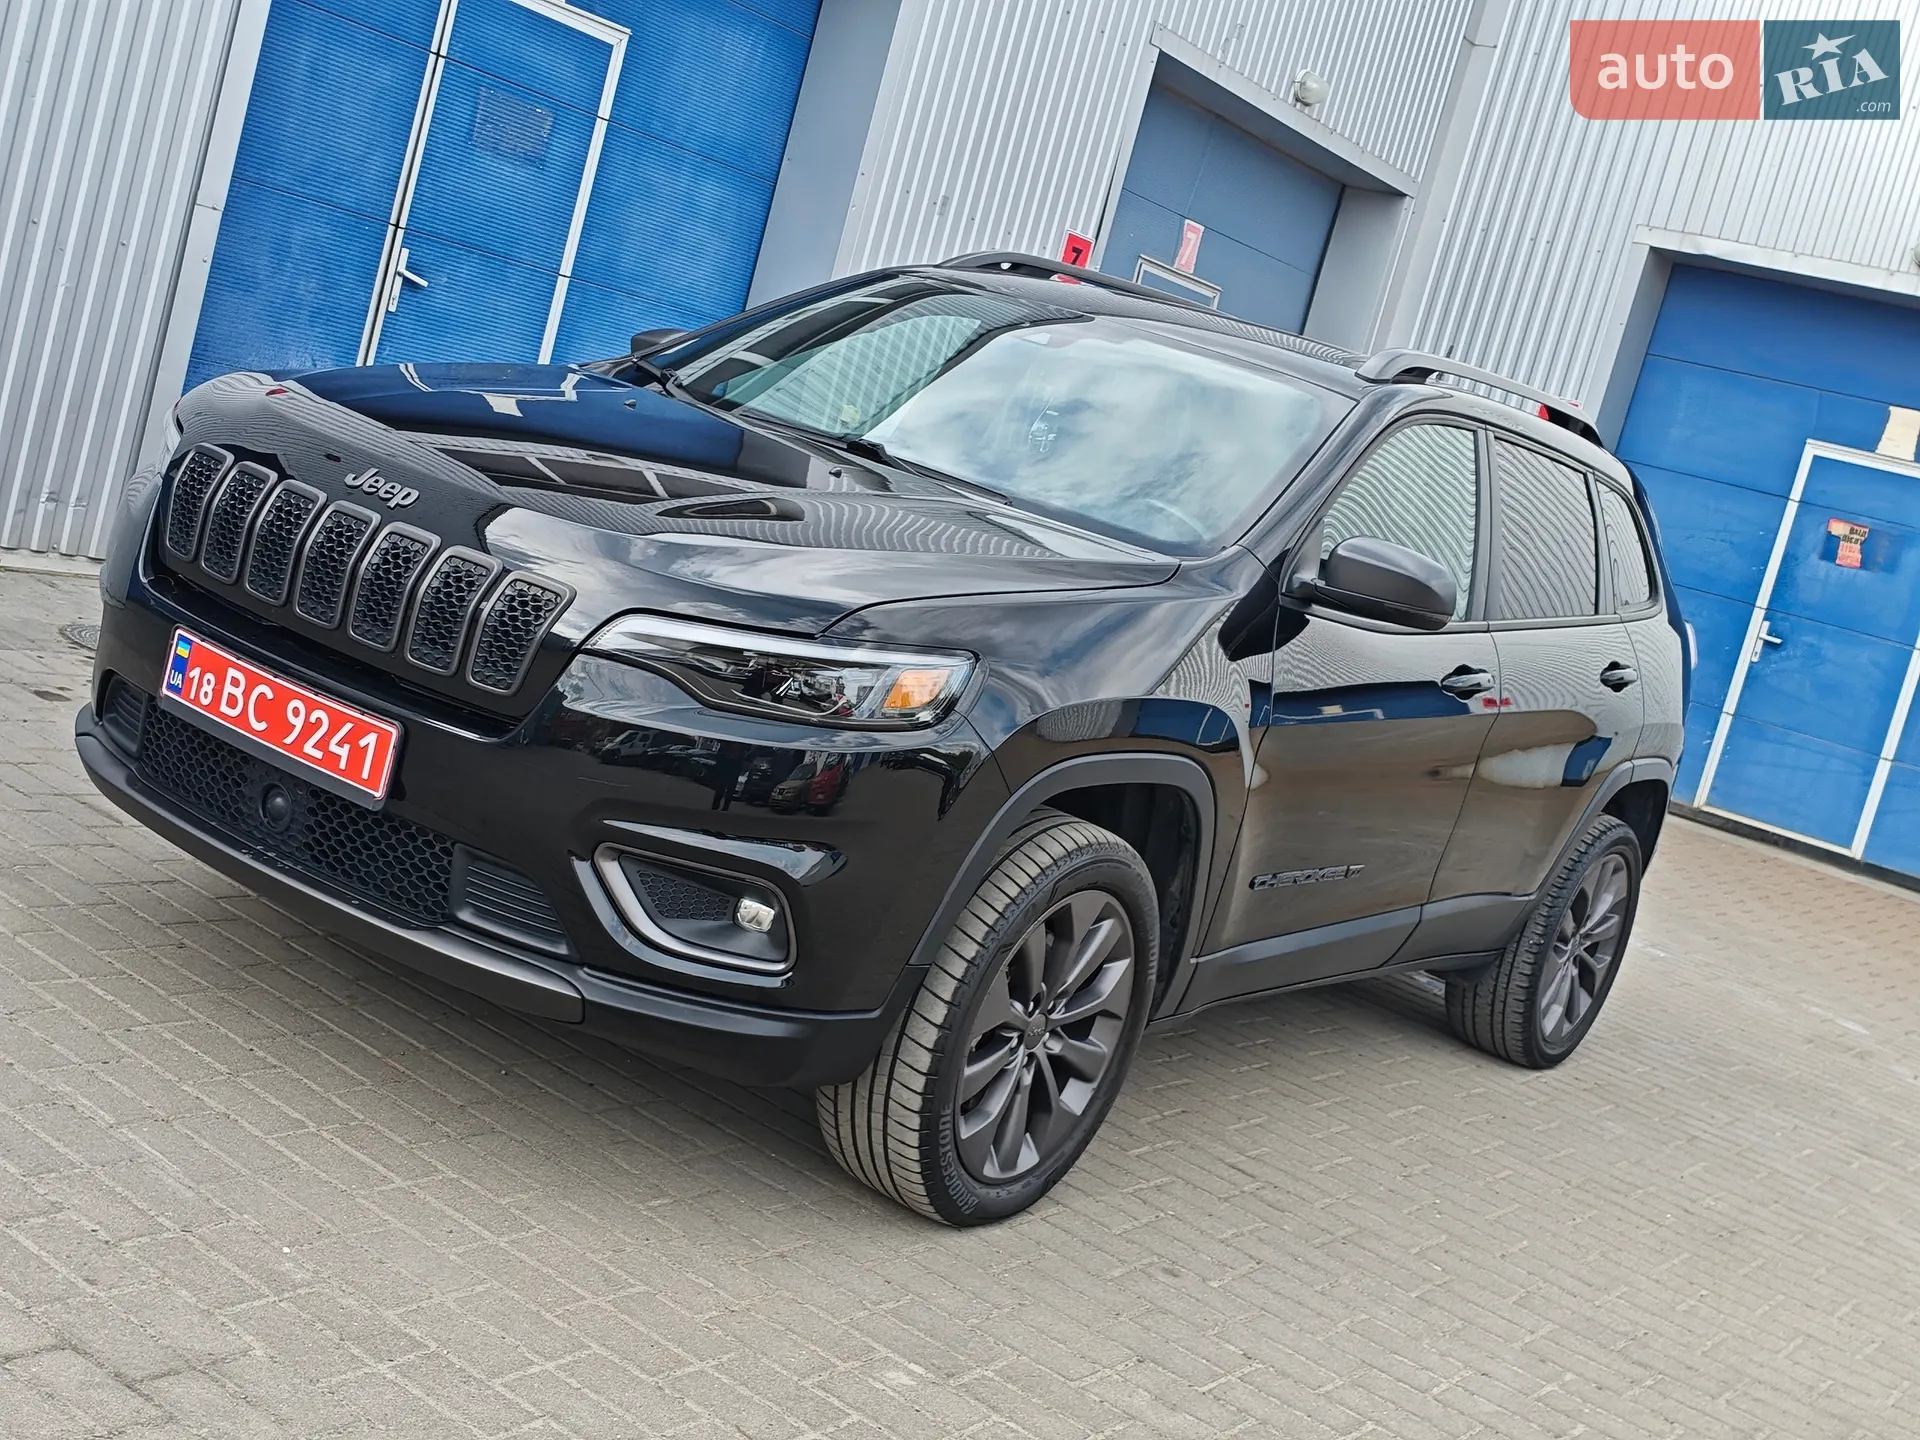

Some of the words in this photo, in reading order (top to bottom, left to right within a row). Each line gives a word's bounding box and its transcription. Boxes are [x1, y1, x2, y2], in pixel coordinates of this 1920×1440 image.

[1071, 246, 1083, 265] 7
[1182, 231, 1197, 265] 7
[344, 467, 420, 509] Jeep
[169, 669, 184, 690] UA
[188, 666, 216, 706] 18
[219, 666, 274, 732] BC
[282, 698, 379, 780] 9241
[939, 1102, 981, 1215] BRIDGESTONE
